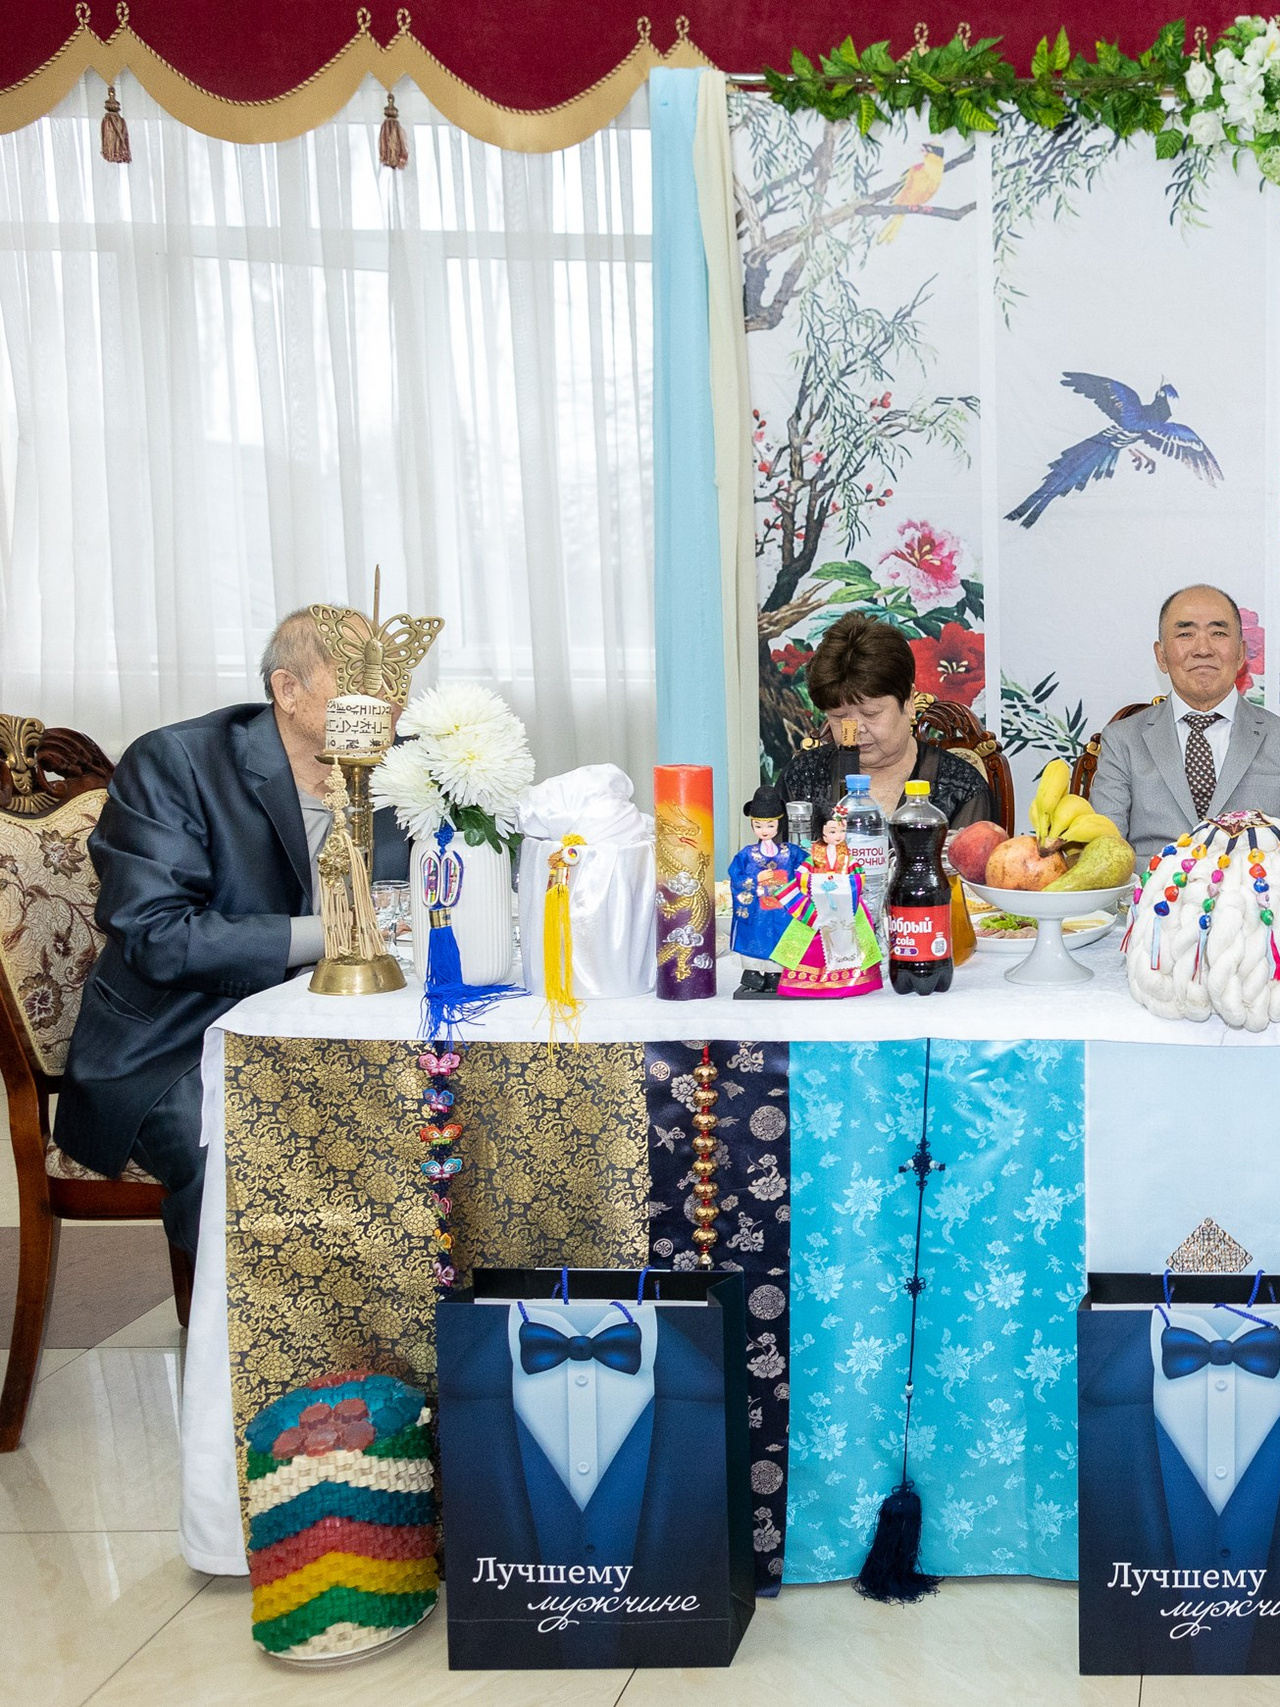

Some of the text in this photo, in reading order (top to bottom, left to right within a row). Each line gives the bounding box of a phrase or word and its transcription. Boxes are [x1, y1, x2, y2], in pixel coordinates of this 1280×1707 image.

[895, 936, 916, 946] cola
[472, 1557, 634, 1593] Лучшему
[1106, 1562, 1268, 1596] Лучшему
[527, 1595, 701, 1633] мужчине
